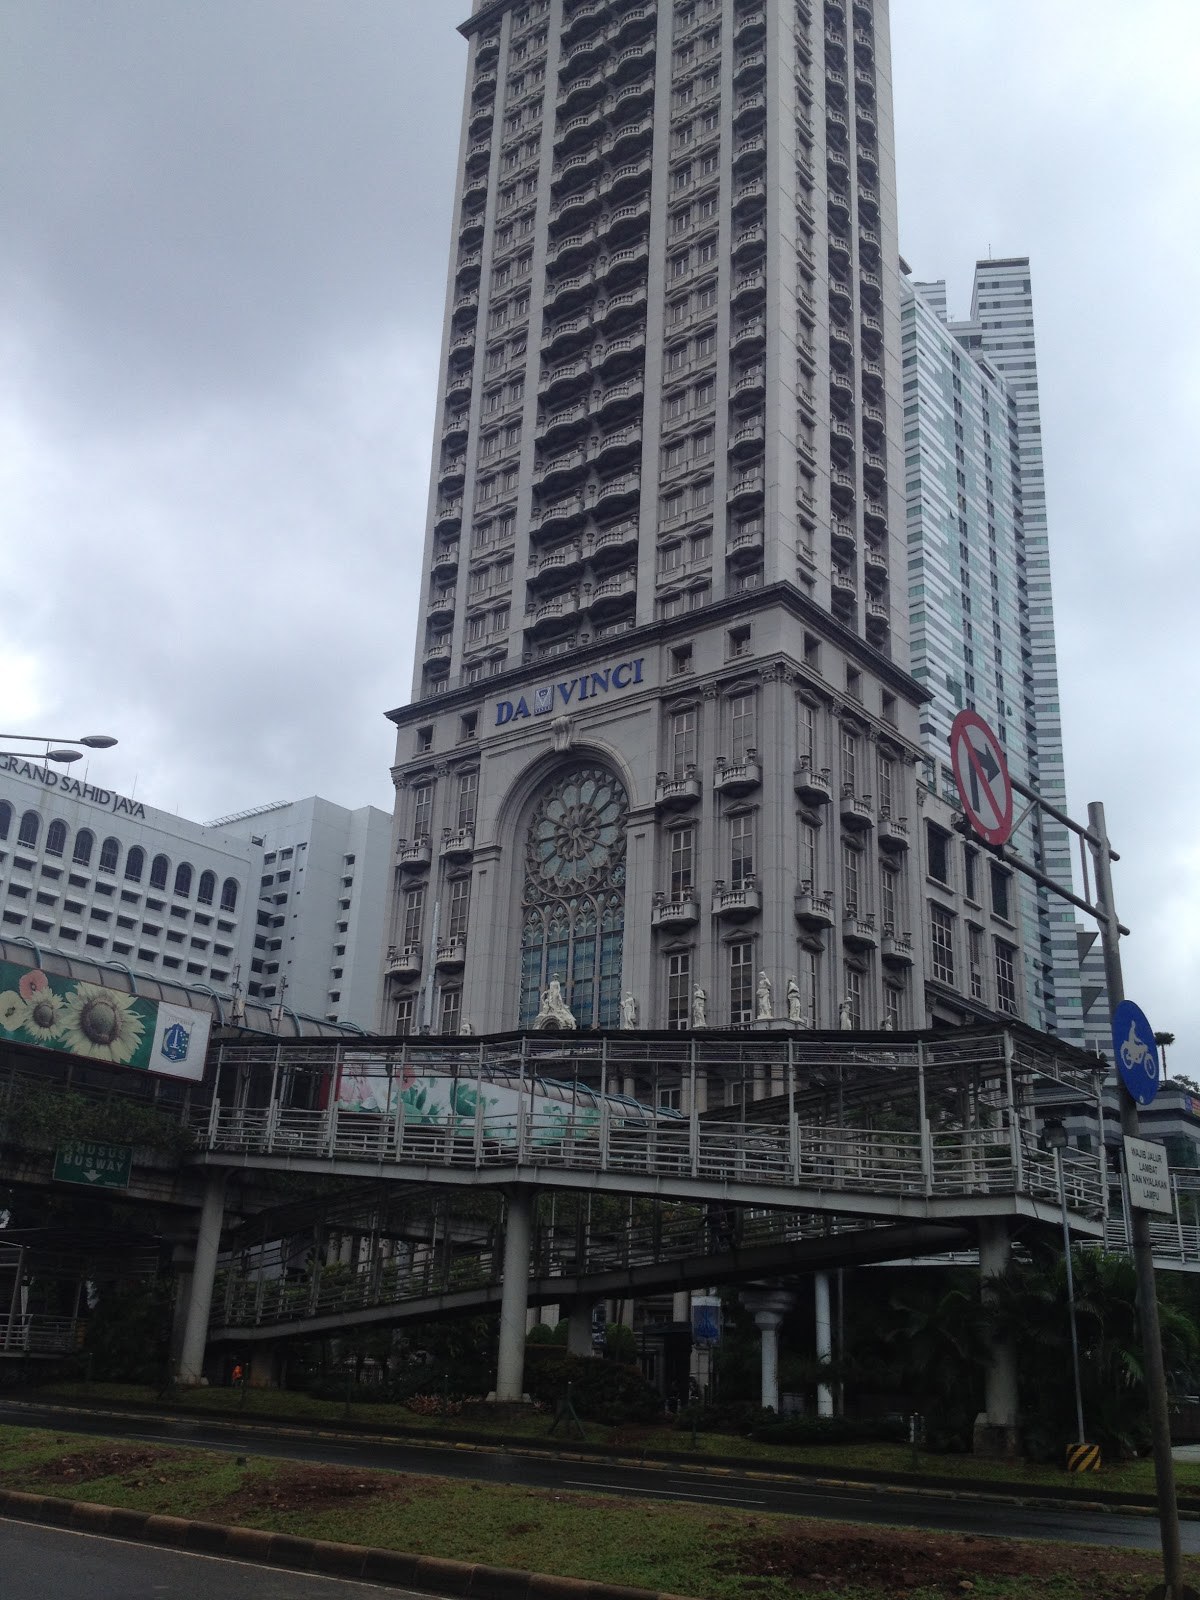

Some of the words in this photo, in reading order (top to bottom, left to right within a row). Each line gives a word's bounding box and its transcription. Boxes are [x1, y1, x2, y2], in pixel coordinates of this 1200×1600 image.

[495, 696, 531, 726] DA
[557, 658, 644, 704] VINCI
[0, 756, 58, 786] GRAND
[60, 776, 111, 805] SAHID
[110, 795, 146, 819] JAYA
[63, 1154, 124, 1172] BUSWAY
[1131, 1147, 1147, 1159] WAJIB
[1147, 1151, 1162, 1163] JALUR
[1138, 1162, 1158, 1175] LAMBAT
[1131, 1173, 1142, 1184] DAN
[1142, 1176, 1168, 1189] NYALAKAN
[1143, 1189, 1160, 1201] LAMPU
